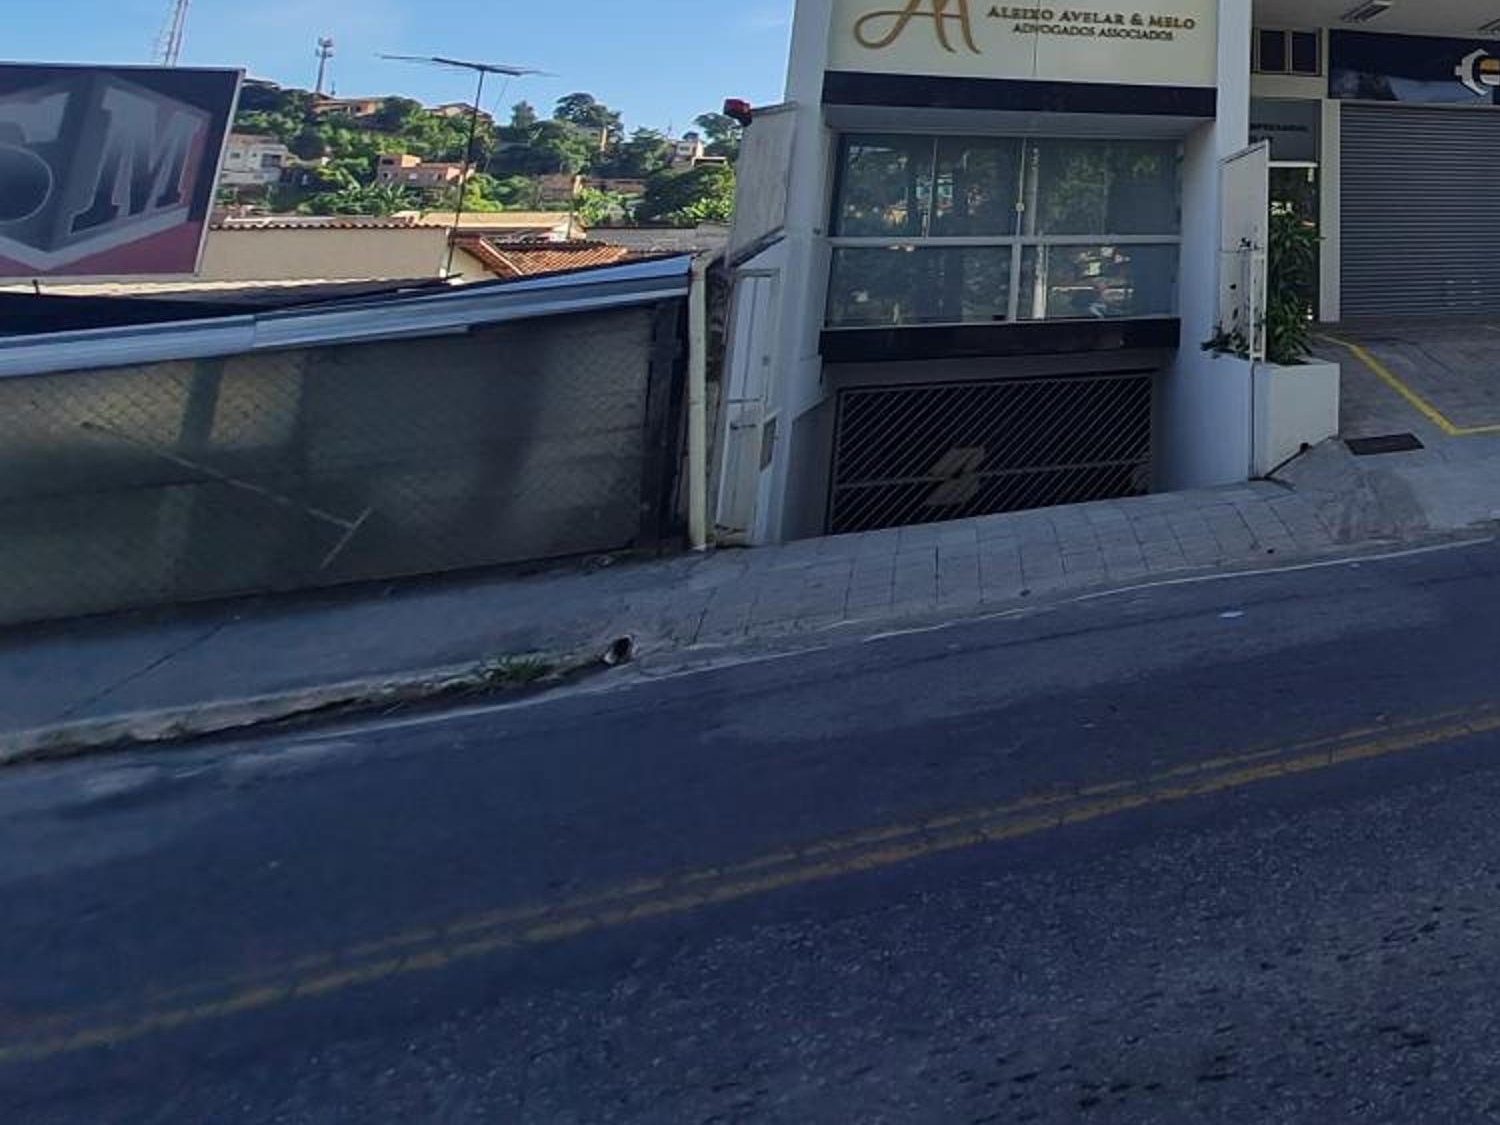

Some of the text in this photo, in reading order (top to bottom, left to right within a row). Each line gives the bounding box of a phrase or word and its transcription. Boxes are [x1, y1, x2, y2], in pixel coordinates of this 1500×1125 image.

[986, 5, 1195, 30] ALEIXO AVELAR & MELO
[1012, 23, 1173, 41] ADVOGADOS ASSOCIADOS
